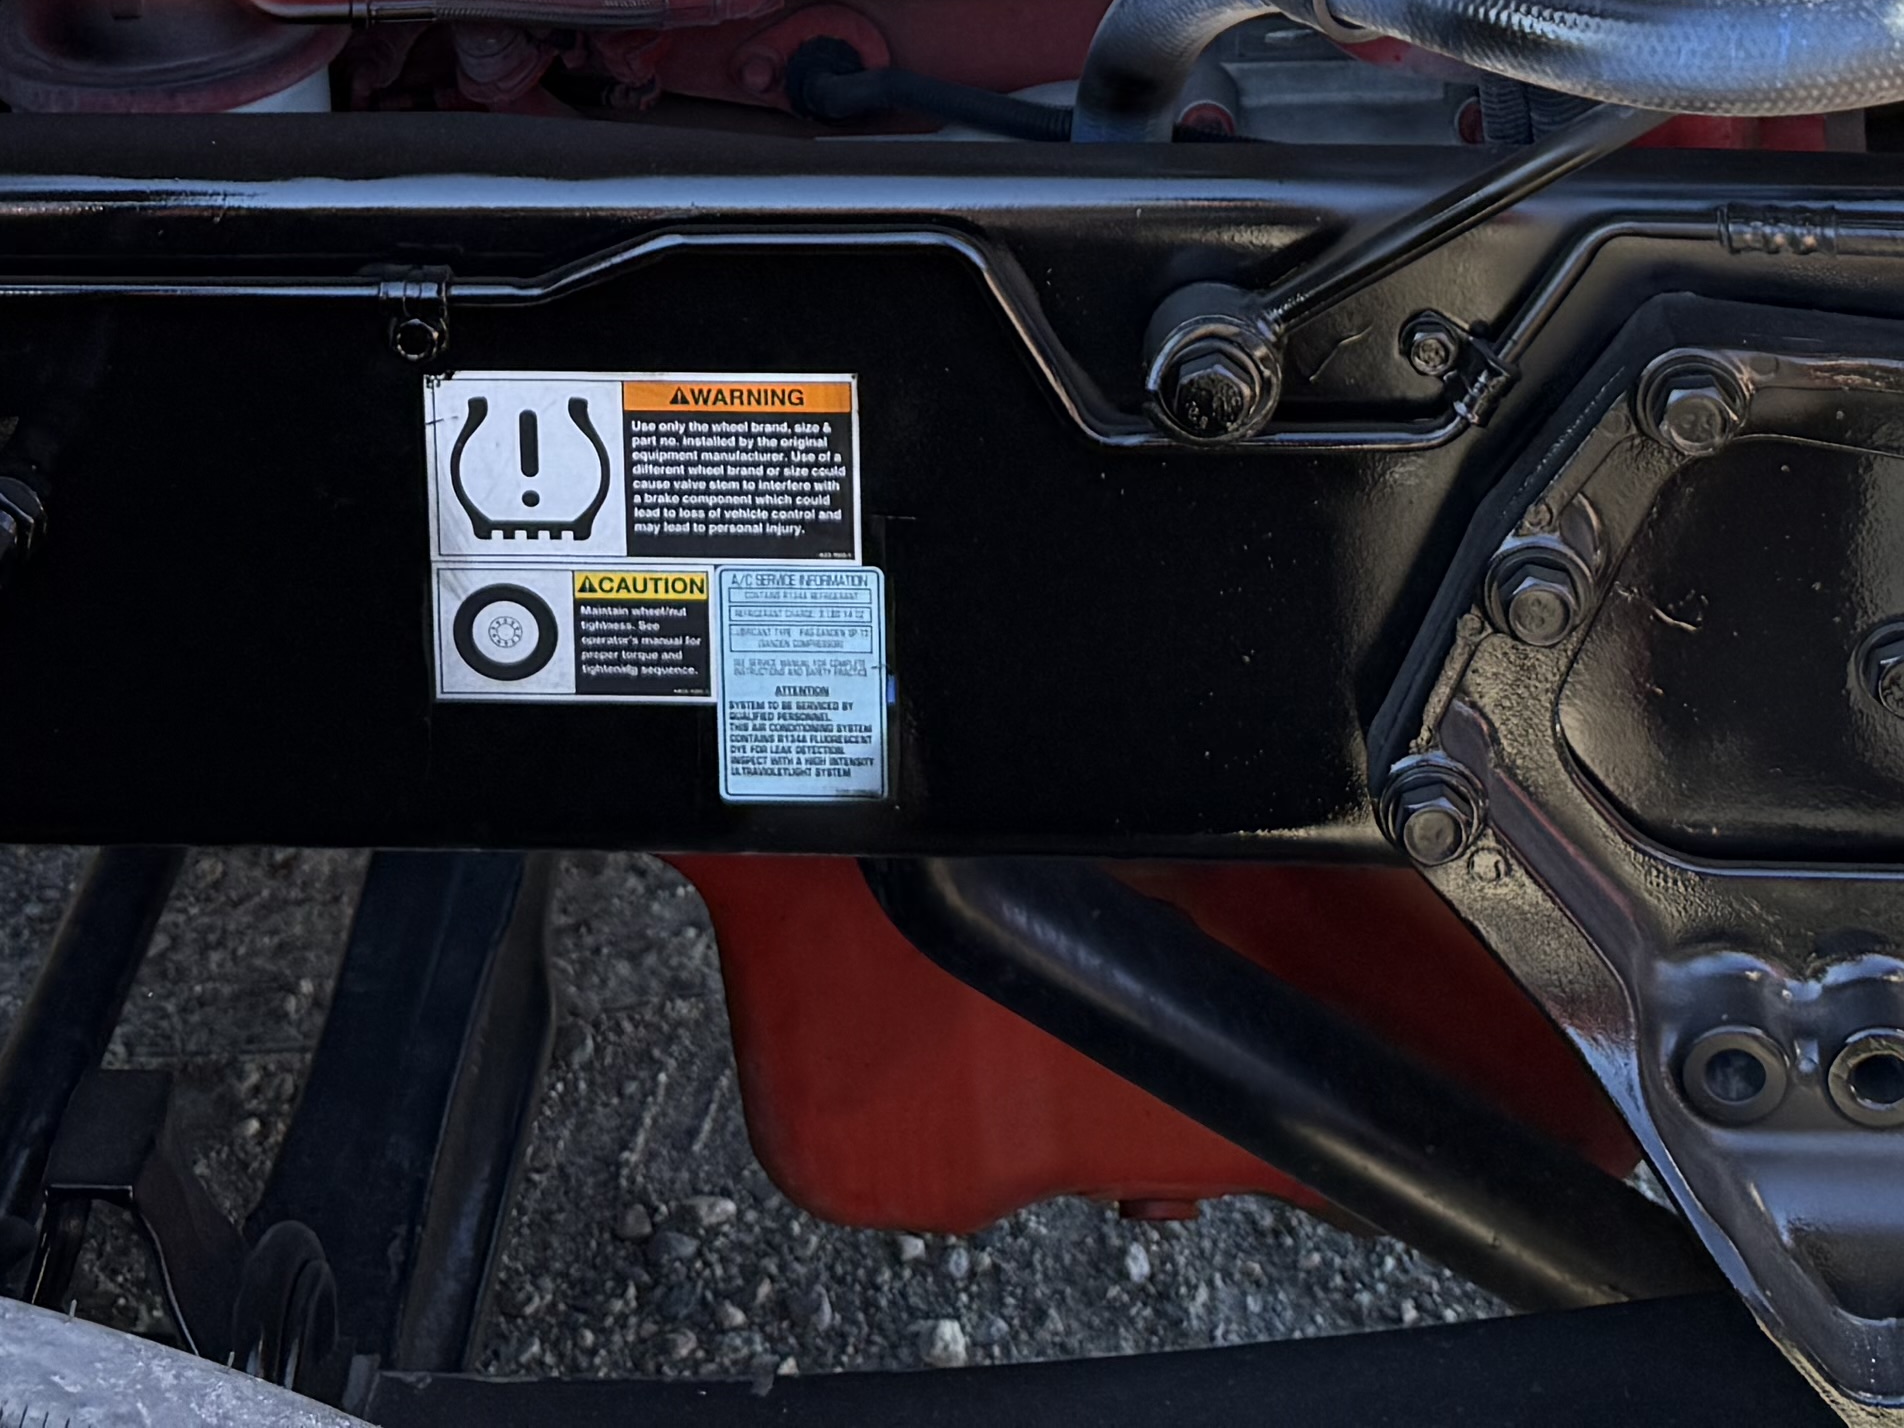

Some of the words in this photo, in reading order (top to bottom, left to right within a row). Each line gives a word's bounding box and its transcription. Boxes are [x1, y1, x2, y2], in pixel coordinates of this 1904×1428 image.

[689, 388, 804, 406] WARNING
[631, 420, 656, 433] Use
[659, 421, 685, 434] only
[689, 421, 709, 433] the
[712, 422, 748, 433] wheel
[751, 422, 791, 434] brand,
[794, 422, 820, 433] size
[822, 423, 832, 433] &
[632, 436, 656, 448] part
[660, 438, 679, 446] no.
[682, 436, 735, 447] installed
[739, 436, 754, 449] by
[757, 436, 778, 447] the
[780, 436, 828, 449] original
[632, 450, 697, 462] equipment
[701, 451, 788, 462] manufacturer.
[791, 451, 815, 462] Use
[818, 451, 831, 462] of
[834, 453, 841, 462] a
[632, 465, 685, 476] different
[688, 465, 724, 476] wheel
[727, 465, 763, 476] brand
[766, 468, 780, 476] or
[784, 466, 808, 477] size
[811, 466, 846, 477] could
[632, 481, 670, 490] cause
[673, 479, 706, 490] valve
[709, 479, 739, 490] stem
[743, 480, 754, 490] to
[758, 480, 811, 491] interfere
[813, 480, 840, 492] with
[633, 495, 641, 503] a
[644, 493, 679, 504] brake
[682, 494, 752, 506] component
[755, 494, 792, 505] which
[795, 494, 830, 506] could
[634, 507, 660, 518] lead
[663, 508, 676, 518] to
[679, 508, 705, 519] loss
[708, 508, 721, 519] of
[724, 508, 768, 519] vehicle
[771, 508, 815, 520] control
[818, 509, 842, 520] and
[634, 524, 660, 535] may
[663, 522, 689, 532] lead
[693, 522, 705, 533] to
[708, 522, 763, 535] personal
[766, 523, 805, 536] injury.
[598, 576, 705, 594] CAUTION
[732, 574, 753, 585] A/C
[755, 574, 796, 586] SERVICE
[799, 575, 868, 587] INFORMATION
[580, 605, 628, 616] Maintain
[631, 606, 687, 616] wheel/nut
[582, 651, 618, 660] proper
[621, 650, 658, 661] torque
[661, 650, 682, 659] and
[775, 686, 829, 697] ATTENTION
